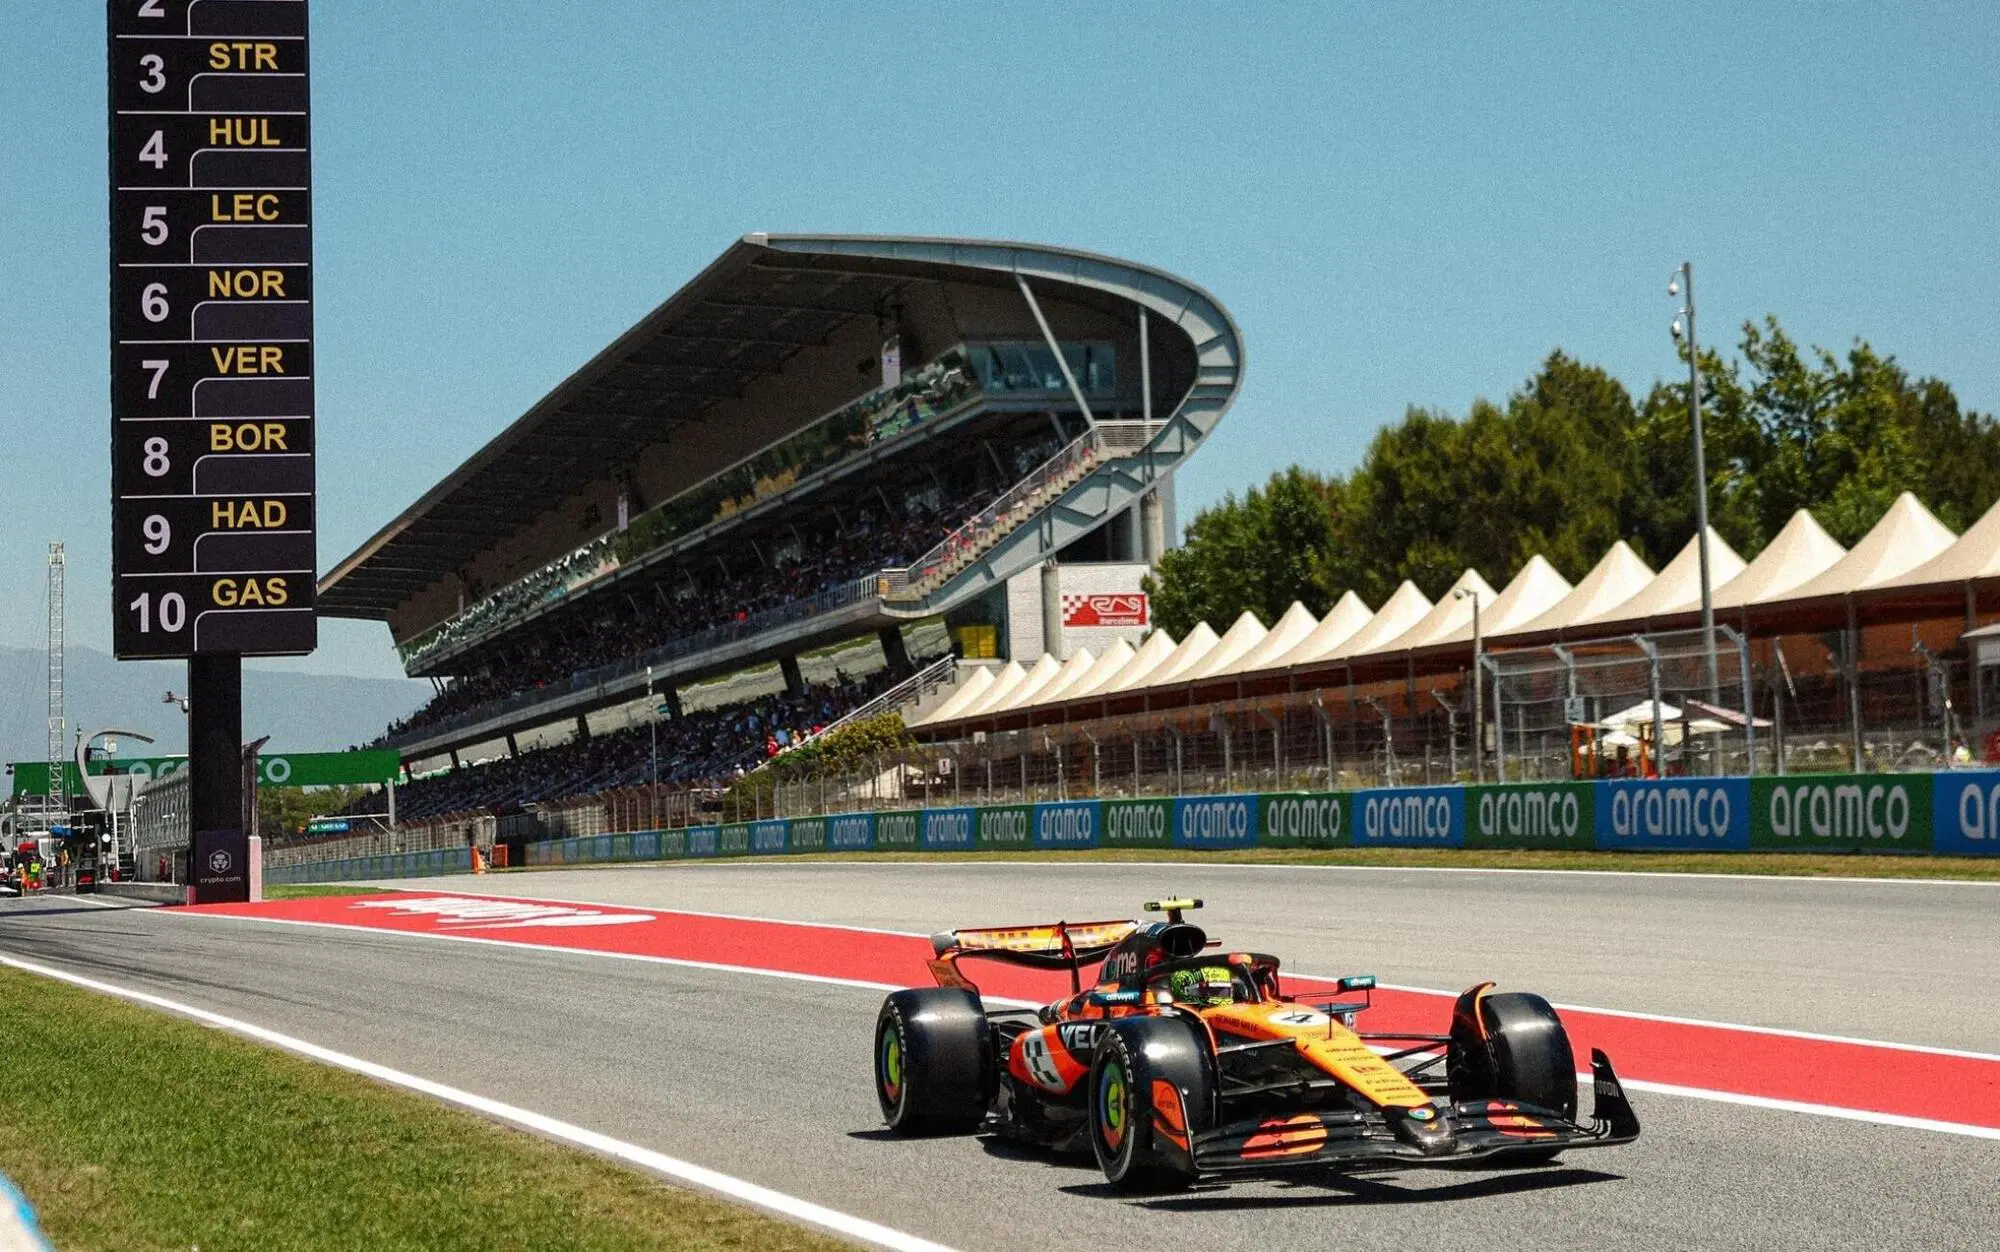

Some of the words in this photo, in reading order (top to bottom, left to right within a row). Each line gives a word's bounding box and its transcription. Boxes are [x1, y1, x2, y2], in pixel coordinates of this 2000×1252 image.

[139, 54, 166, 93] 3
[209, 43, 278, 70] STR
[138, 130, 168, 169] 4
[210, 118, 280, 145] HUL
[141, 206, 169, 245] 5
[212, 194, 279, 221] LEC
[141, 283, 169, 322] 6
[209, 270, 285, 297] NOR
[142, 360, 169, 399] 7
[211, 346, 284, 374] VER
[143, 436, 170, 476] 8
[210, 423, 287, 450] BOR
[143, 514, 171, 555] 9
[212, 501, 287, 528] HAD
[130, 591, 186, 633] 10
[212, 577, 287, 606] GAS
[832, 818, 868, 845] aramco
[878, 815, 916, 843] aramco
[927, 813, 969, 842] aramco
[980, 811, 1027, 841] aramco
[1040, 807, 1092, 841] aramco
[1107, 802, 1165, 838] aramco
[1182, 802, 1247, 838] aramco
[1267, 799, 1340, 837] aramco
[1365, 795, 1449, 837] aramco
[1479, 792, 1579, 836] aramco
[1612, 787, 1730, 838] aramco
[1769, 784, 1909, 839] aramco
[1061, 1025, 1098, 1049] VEL
